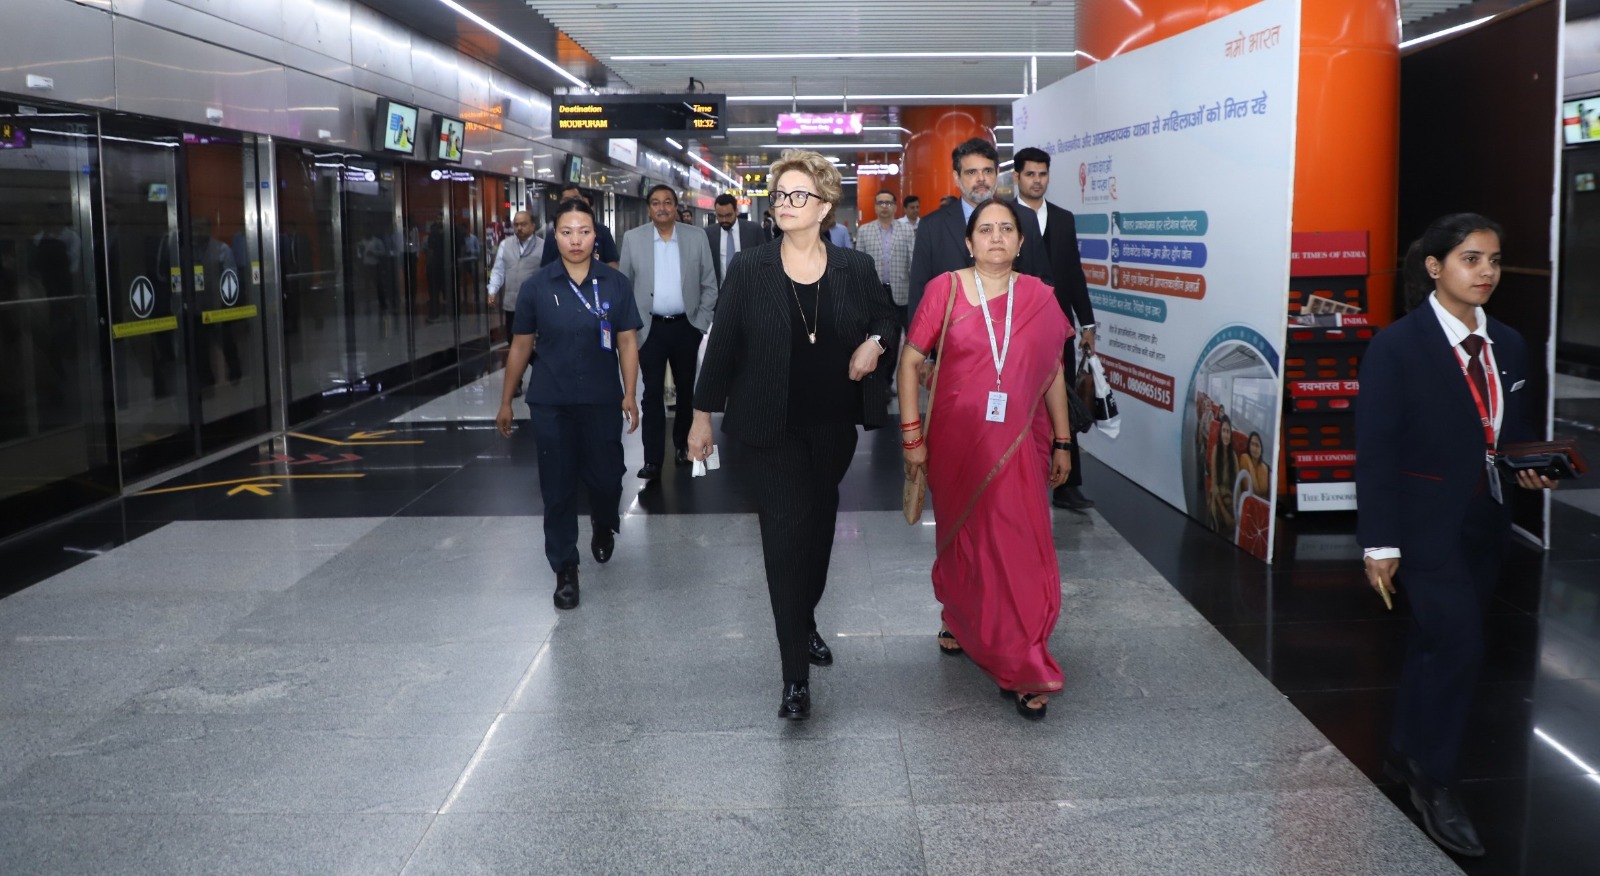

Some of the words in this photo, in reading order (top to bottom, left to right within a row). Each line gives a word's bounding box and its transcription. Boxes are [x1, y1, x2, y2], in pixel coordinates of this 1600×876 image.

[1225, 30, 1246, 58] नमो
[1248, 25, 1281, 53] भारत
[558, 104, 602, 113] Destination
[692, 104, 713, 113] Time
[558, 119, 608, 129] MODIPURAM
[693, 119, 715, 129] 10:32
[1081, 131, 1092, 149] और
[1092, 126, 1131, 147] आरामदायक
[1132, 123, 1151, 138] यात्रा
[1152, 115, 1161, 133] से
[1162, 105, 1205, 132] महिलाओं
[1206, 101, 1221, 123] को
[1223, 96, 1248, 120] मिल
[1251, 90, 1269, 115] रहे
[1302, 251, 1328, 260] TIMES
[1329, 251, 1342, 259] OF
[1342, 250, 1367, 259] INDIA
[1343, 317, 1368, 325] INDIA
[1297, 381, 1341, 392] नवभारत
[1297, 454, 1314, 463] THE
